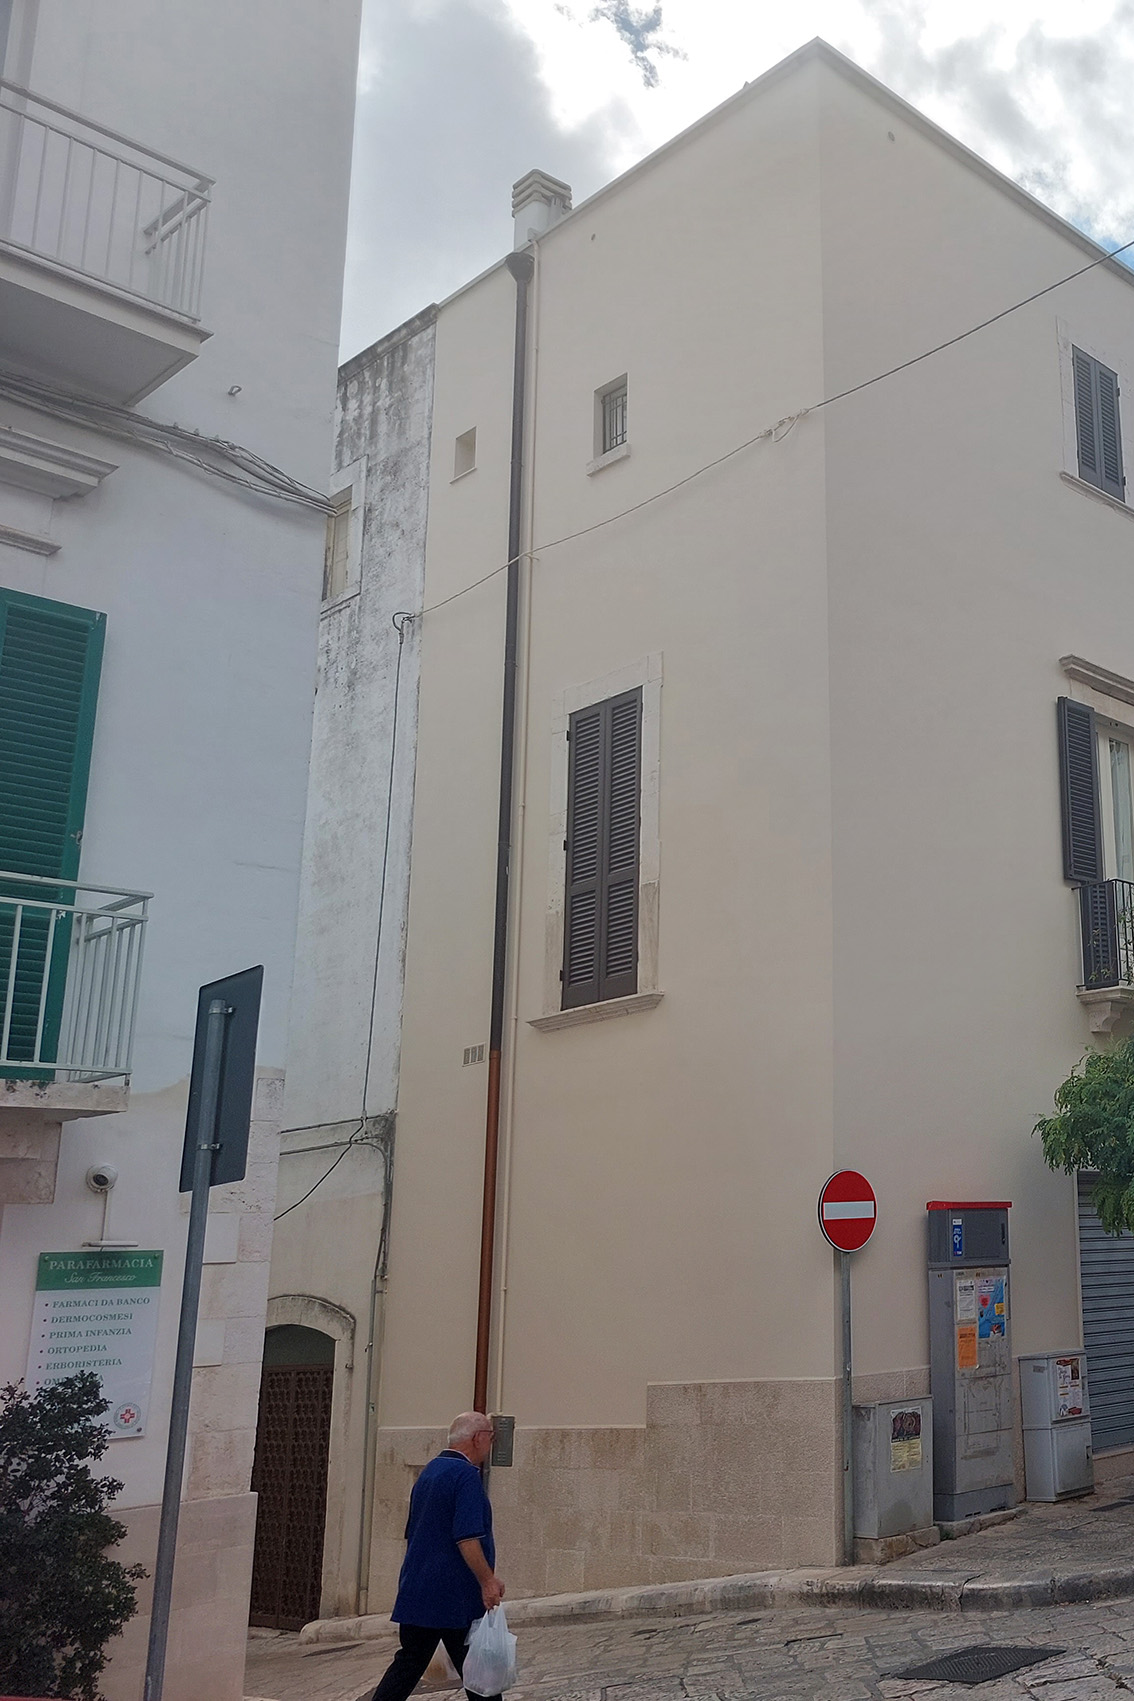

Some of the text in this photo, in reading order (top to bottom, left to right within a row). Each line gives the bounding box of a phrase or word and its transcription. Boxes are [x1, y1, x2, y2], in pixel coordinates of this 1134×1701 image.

[49, 1258, 154, 1270] PARAFARMACIA
[64, 1271, 136, 1283] San Francesco
[52, 1297, 151, 1308] FARMACI DA BANCO
[50, 1312, 133, 1324] DERMOCOSMESI
[49, 1328, 132, 1339] PRIMA INFANZIA
[47, 1344, 107, 1355] ORTOPEDIA
[45, 1358, 123, 1370] ERBORISTERIA
